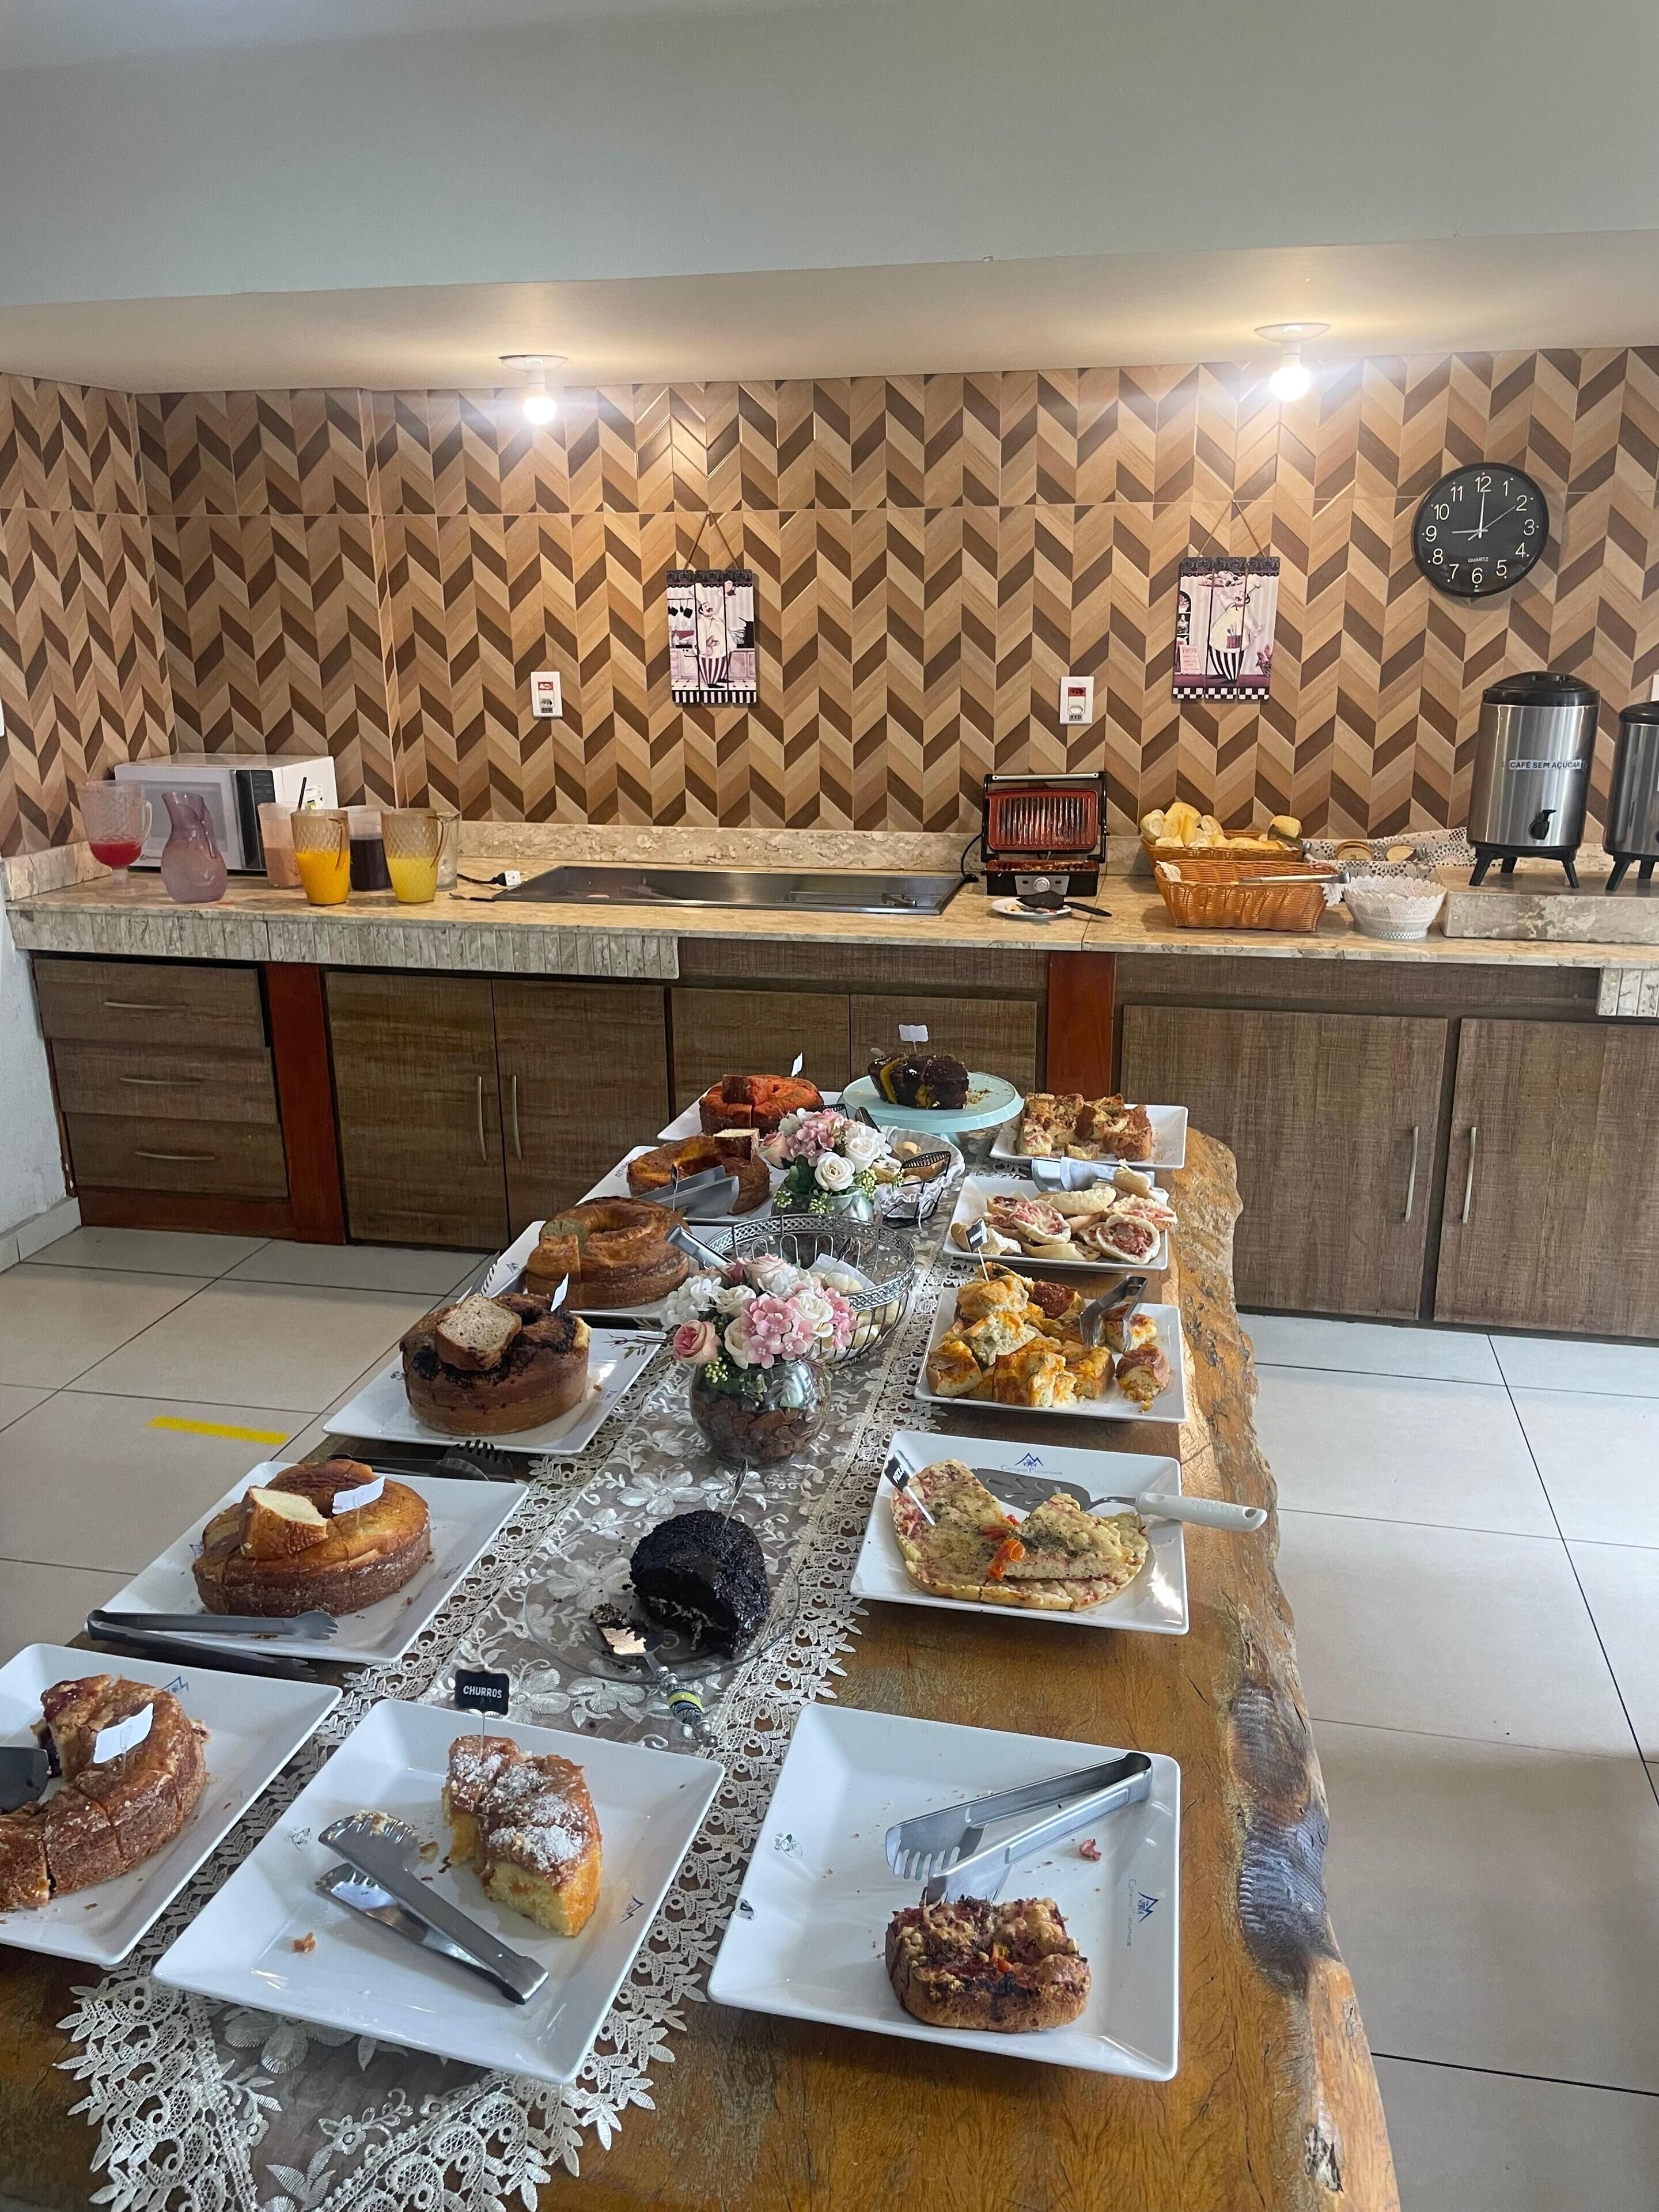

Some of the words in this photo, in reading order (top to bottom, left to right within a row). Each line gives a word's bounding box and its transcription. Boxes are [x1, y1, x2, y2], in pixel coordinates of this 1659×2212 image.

[1475, 476, 1491, 493] 12
[1503, 480, 1508, 497] 1
[1450, 486, 1463, 502] 11
[1434, 503, 1449, 520] 10
[1516, 495, 1528, 512] 2
[1426, 525, 1437, 543] 9
[1523, 519, 1535, 536] 3
[1432, 548, 1443, 565] 8
[1515, 542, 1526, 558] 4
[1449, 563, 1459, 579] 7
[1471, 567, 1483, 584] 6
[1496, 559, 1507, 577] 5
[463, 1685, 502, 1699] CHURROS
